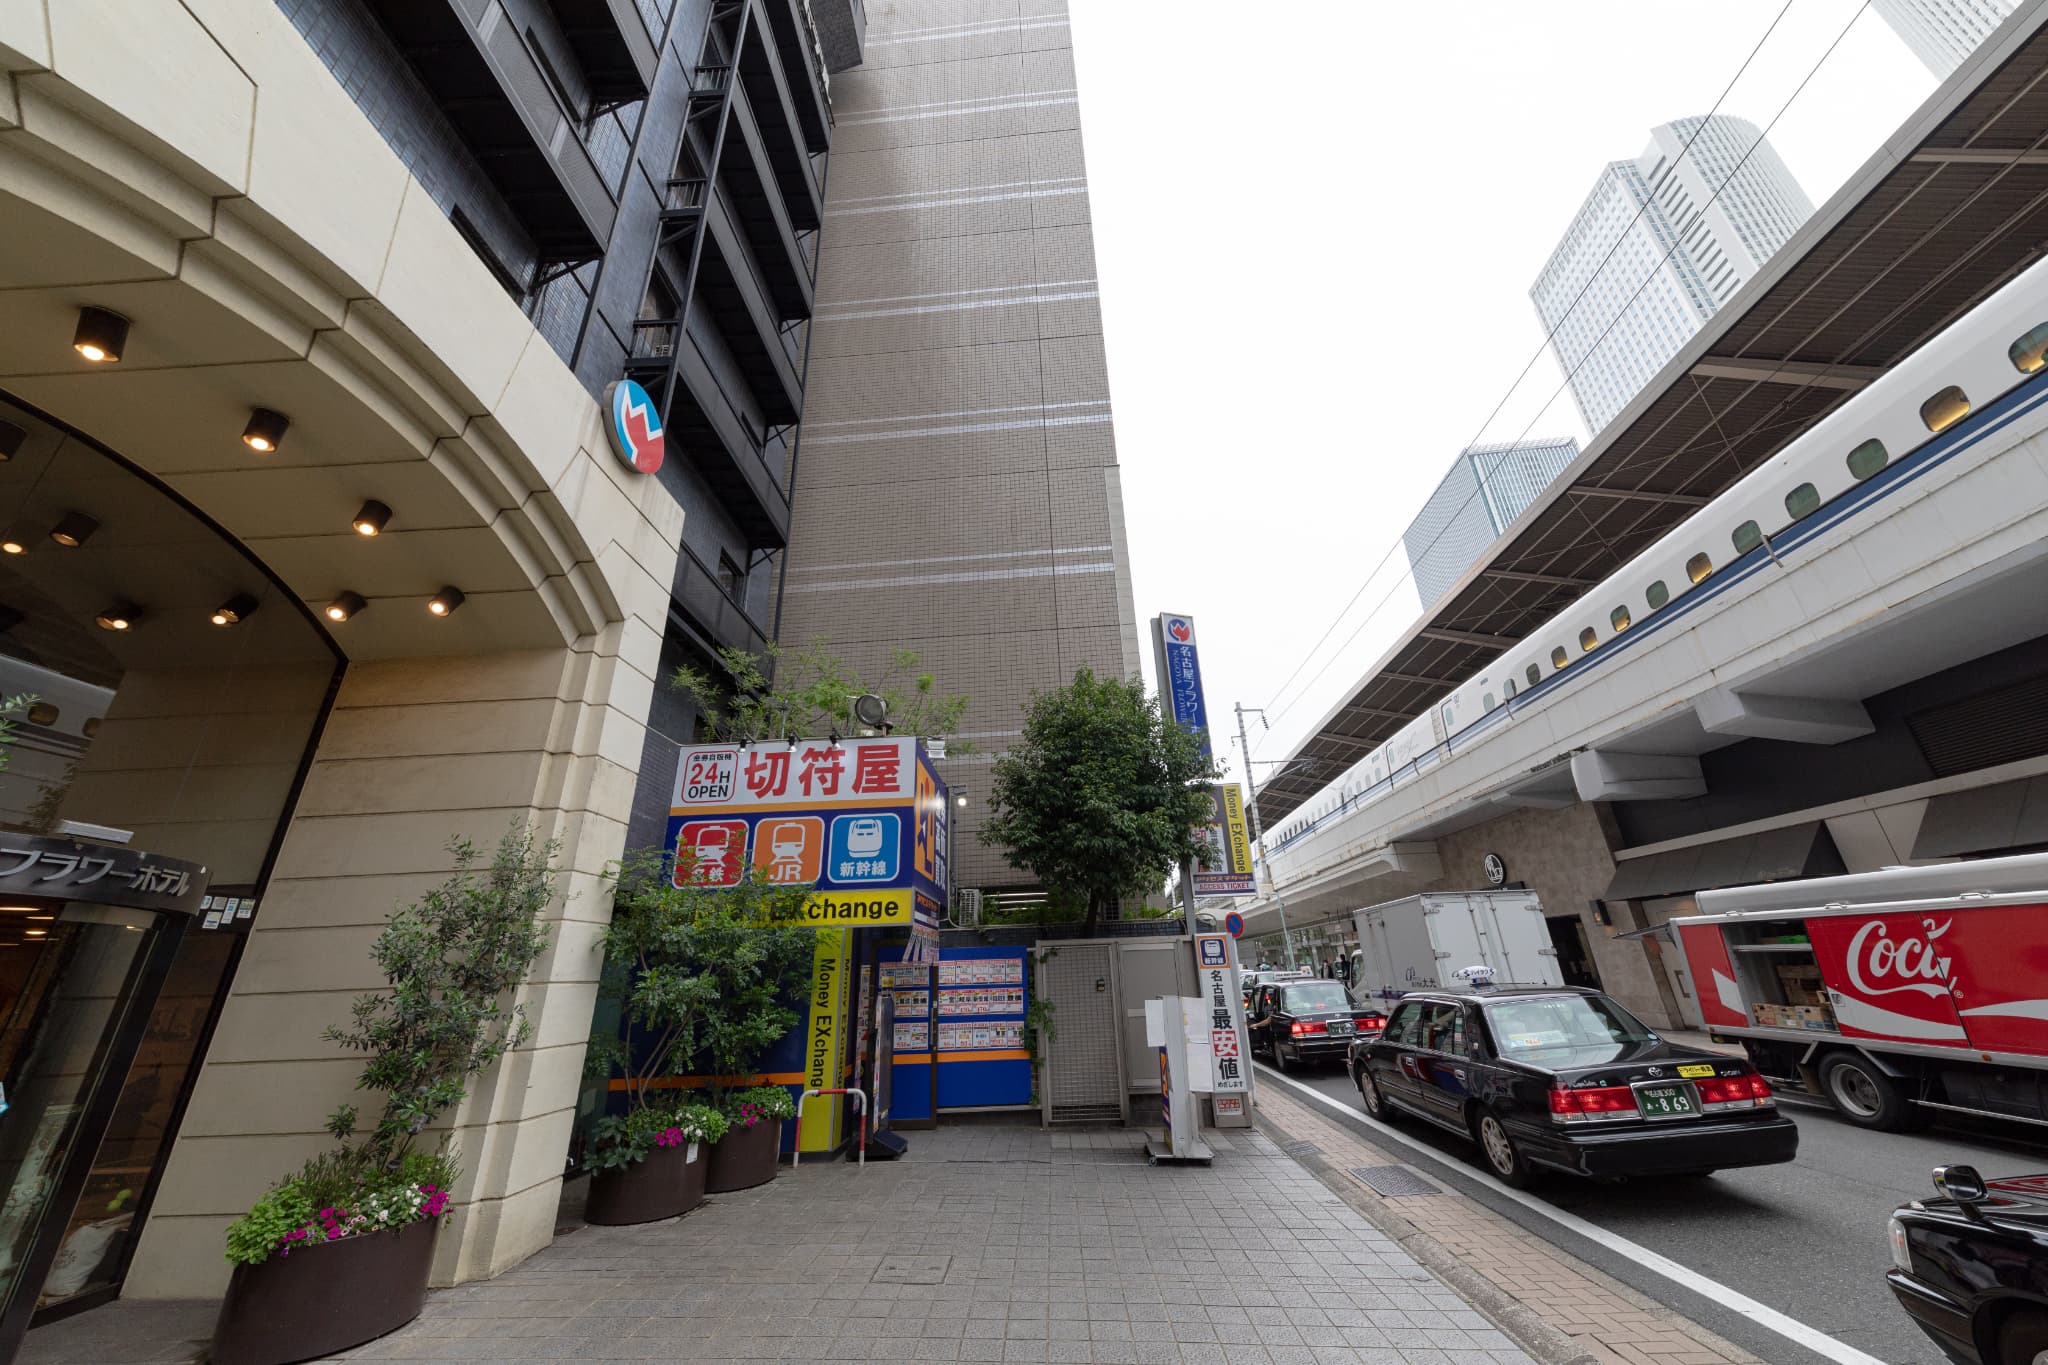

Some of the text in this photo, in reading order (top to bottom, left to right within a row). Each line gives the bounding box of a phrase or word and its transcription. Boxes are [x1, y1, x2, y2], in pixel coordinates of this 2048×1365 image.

[1180, 645, 1201, 736] 名古屋フラワーホ
[689, 762, 731, 785] 24H
[744, 744, 901, 798] 切符屋
[687, 784, 729, 799] OPEN
[1225, 787, 1246, 872] Money EXchange
[769, 864, 802, 881] JR
[839, 861, 888, 878] 新幹線
[790, 898, 900, 921] change
[816, 958, 836, 1009] Money
